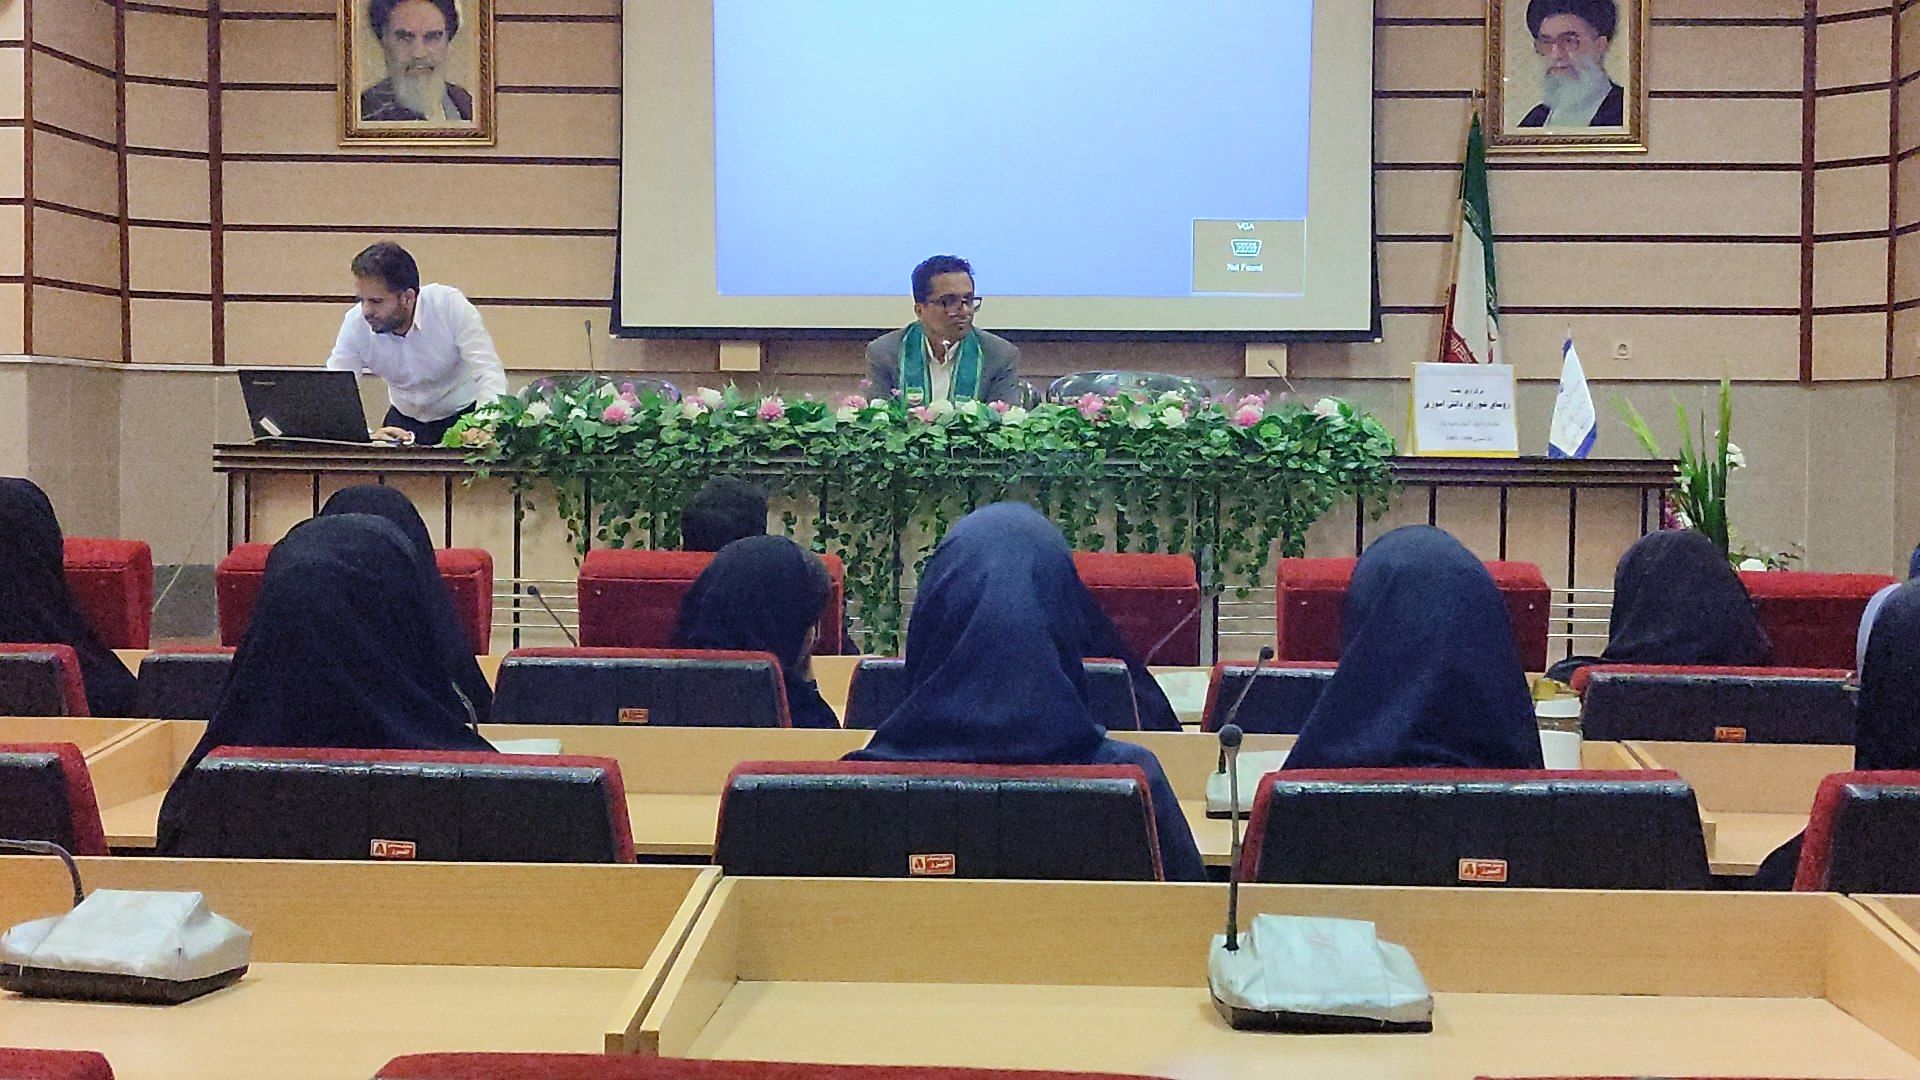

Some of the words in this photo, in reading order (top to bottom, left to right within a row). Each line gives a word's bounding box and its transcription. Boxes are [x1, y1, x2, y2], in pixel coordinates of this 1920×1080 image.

[1237, 222, 1255, 231] VGA
[1227, 263, 1240, 271] Not
[1241, 263, 1263, 271] Found
